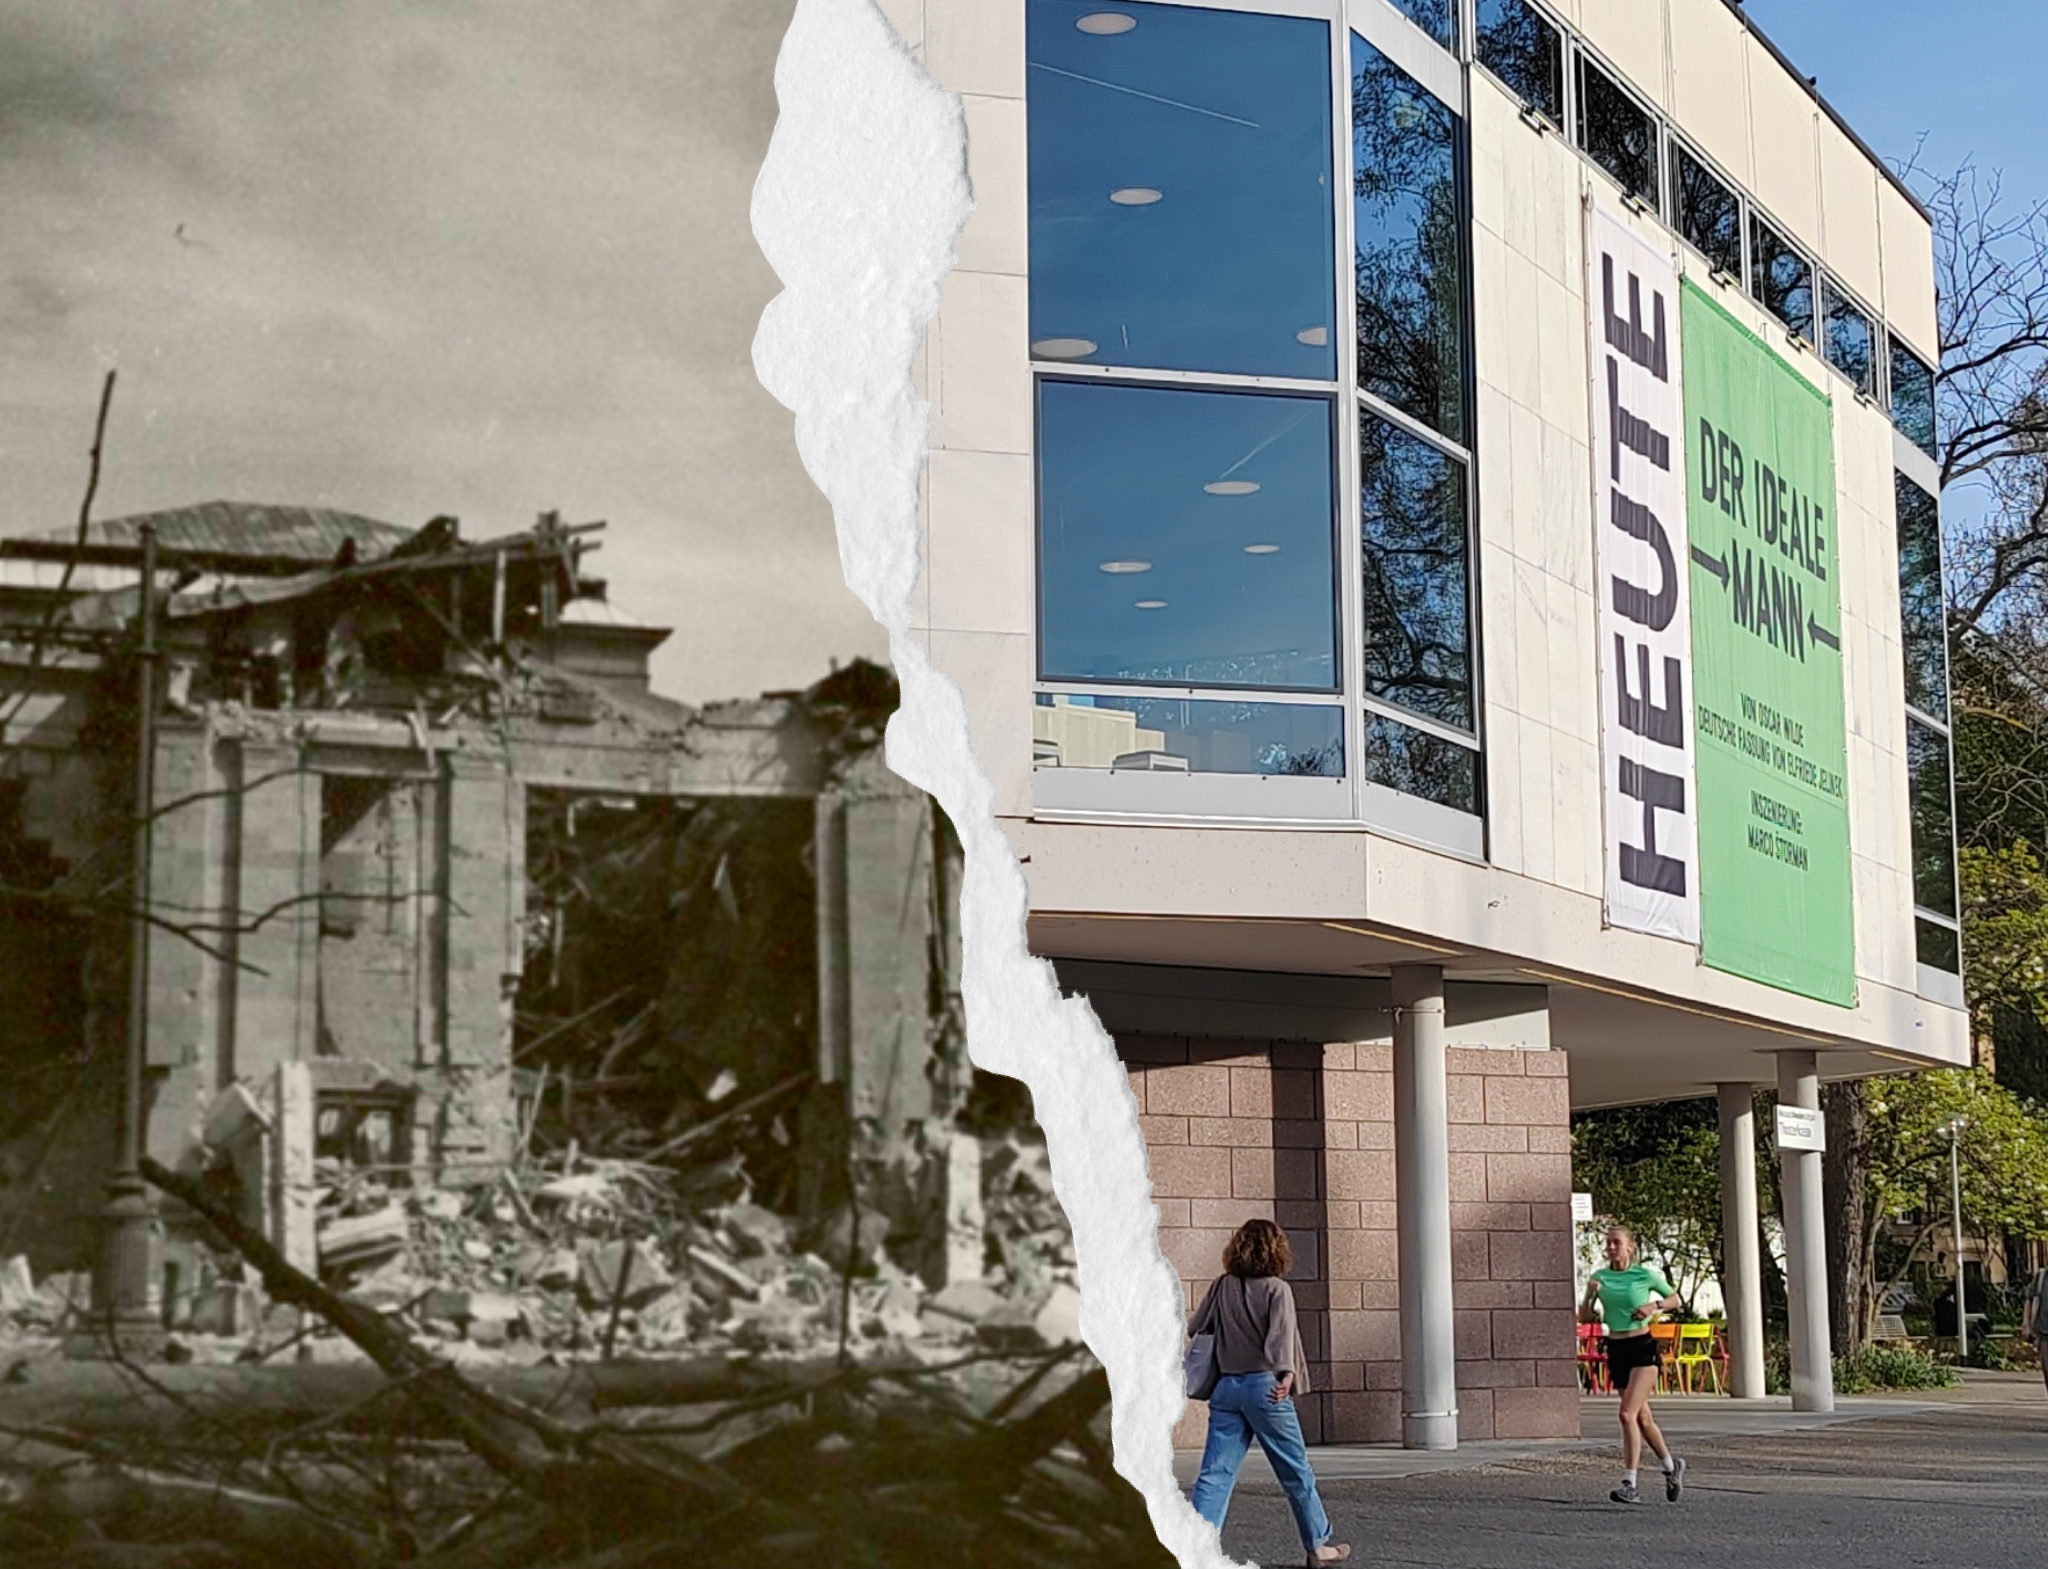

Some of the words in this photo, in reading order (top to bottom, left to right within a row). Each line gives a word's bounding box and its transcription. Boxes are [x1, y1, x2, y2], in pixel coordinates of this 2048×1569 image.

[1700, 416, 1746, 528] DER
[1754, 459, 1827, 581] IDEALE
[1602, 252, 1686, 898] HEUTE
[1731, 538, 1805, 664] MANN
[1698, 704, 1736, 748] DEUTSCHE
[1738, 726, 1770, 765] FASSUNG
[1772, 743, 1787, 773] VON
[1788, 752, 1817, 787] ELFRIEDE
[1741, 693, 1758, 723] VON
[1758, 703, 1781, 735] OSCAR
[1783, 717, 1804, 748] WILDE
[1748, 824, 1773, 857] MARCO
